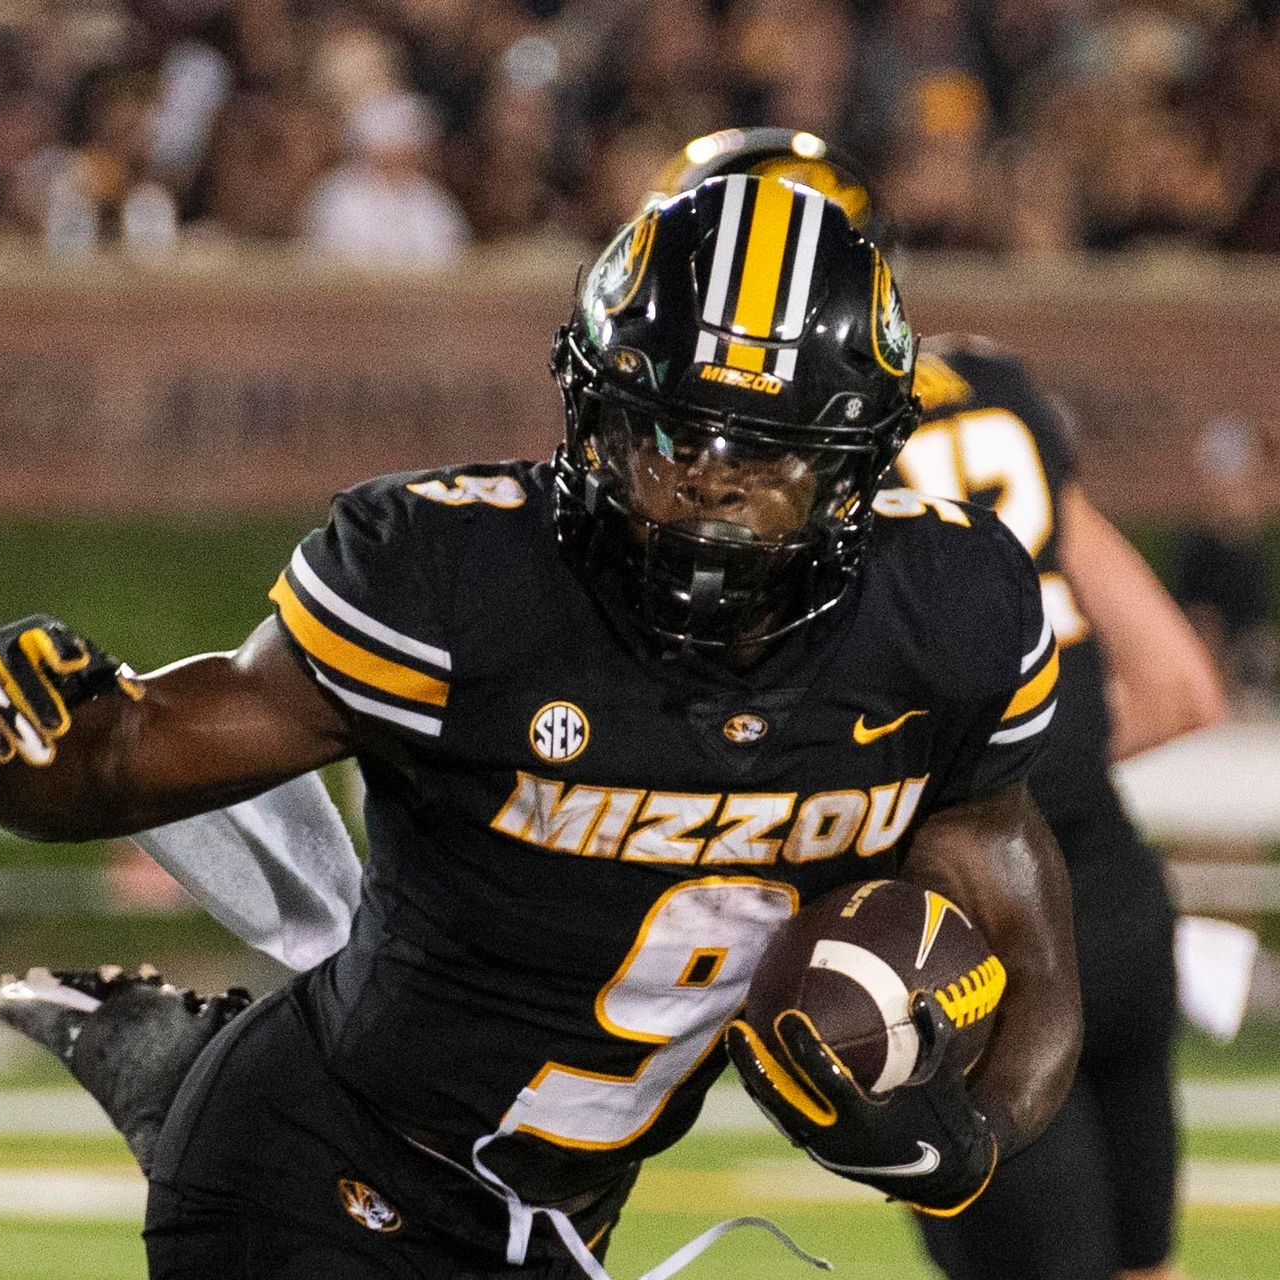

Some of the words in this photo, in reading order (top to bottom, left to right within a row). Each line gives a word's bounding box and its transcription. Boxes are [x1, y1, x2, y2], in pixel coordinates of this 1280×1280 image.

[532, 704, 586, 760] SEC
[490, 771, 929, 864] MIZZOU
[501, 876, 800, 1151] 9
